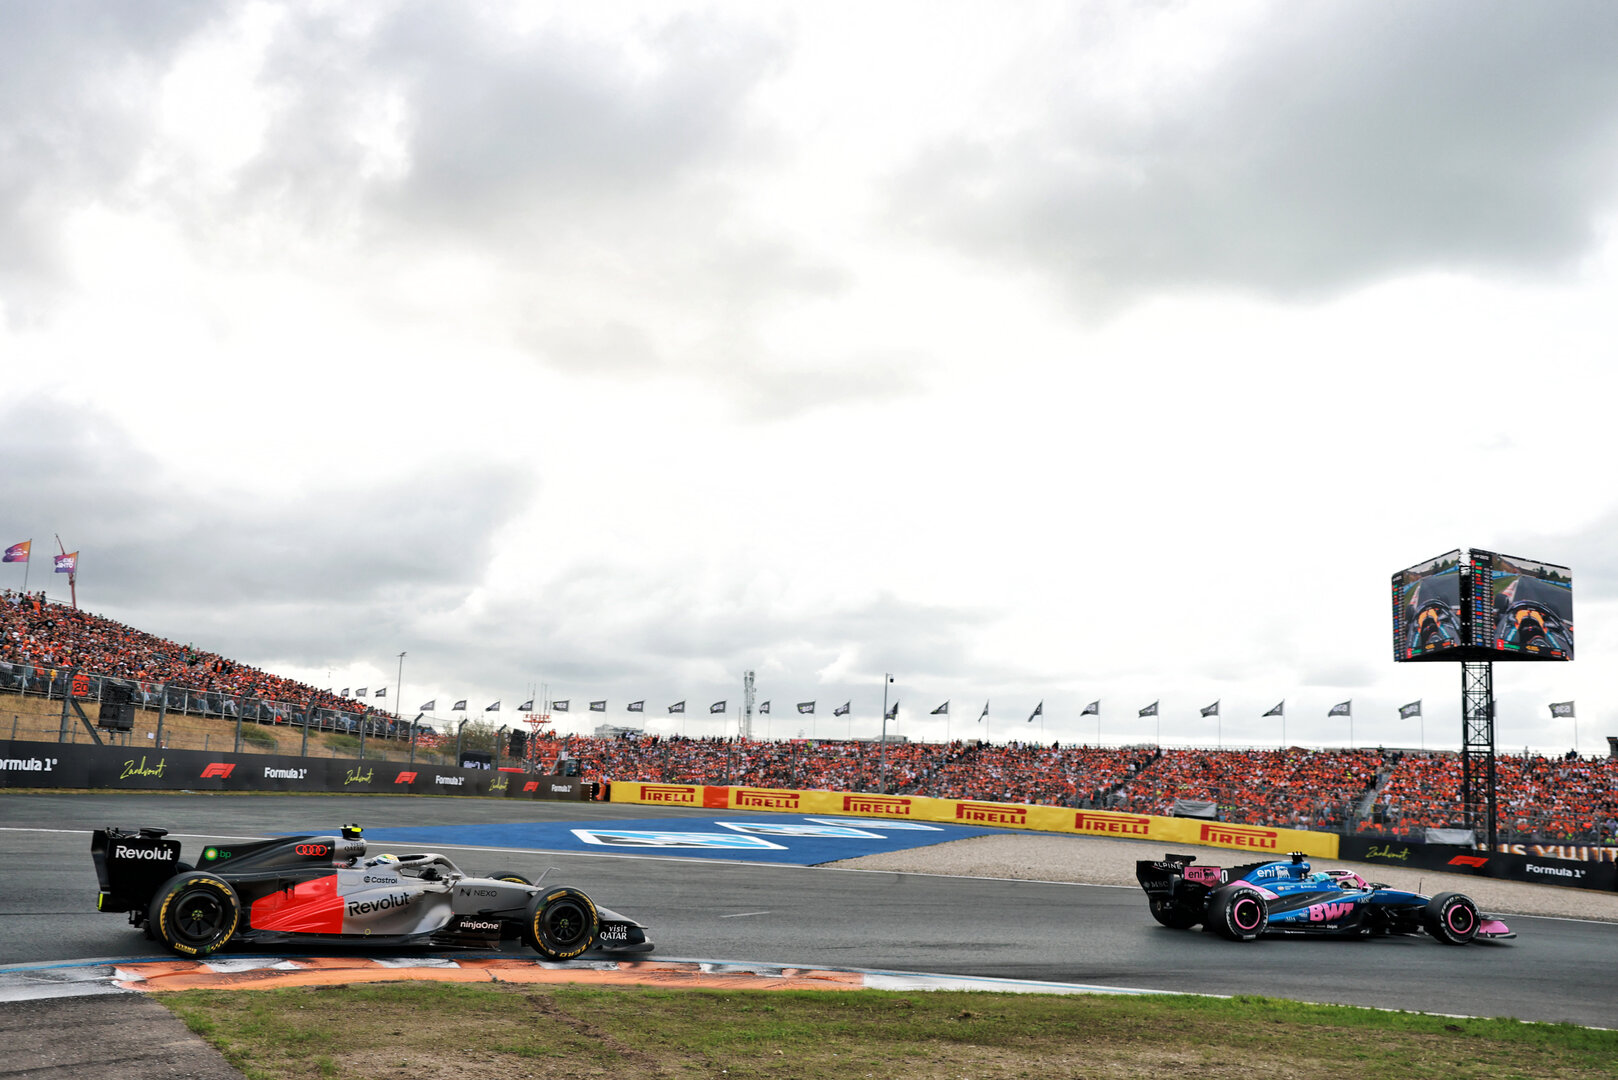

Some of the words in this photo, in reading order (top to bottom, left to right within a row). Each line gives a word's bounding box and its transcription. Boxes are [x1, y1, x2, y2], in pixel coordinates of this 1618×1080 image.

[264, 767, 298, 779] Formula
[435, 775, 457, 785] Formula
[640, 785, 695, 803] PIRELLI
[736, 790, 800, 809] PIRELLI
[843, 795, 911, 815] PIRELLI
[956, 803, 1027, 825] PIRELLI
[1075, 812, 1150, 835] PIRELLI
[1200, 823, 1278, 849] PIRELLI
[115, 845, 173, 861] Revolut
[219, 850, 232, 859] bp
[1153, 862, 1182, 870] ALPINE
[1256, 866, 1275, 878] eni
[1526, 864, 1573, 877] Formula
[1188, 869, 1202, 879] eni
[473, 888, 497, 897] NEXO
[348, 891, 410, 916] Revolut
[1308, 902, 1354, 921] BWT
[460, 919, 499, 931] ninjaOne
[608, 924, 627, 933] visit
[600, 931, 627, 940] QATAR
